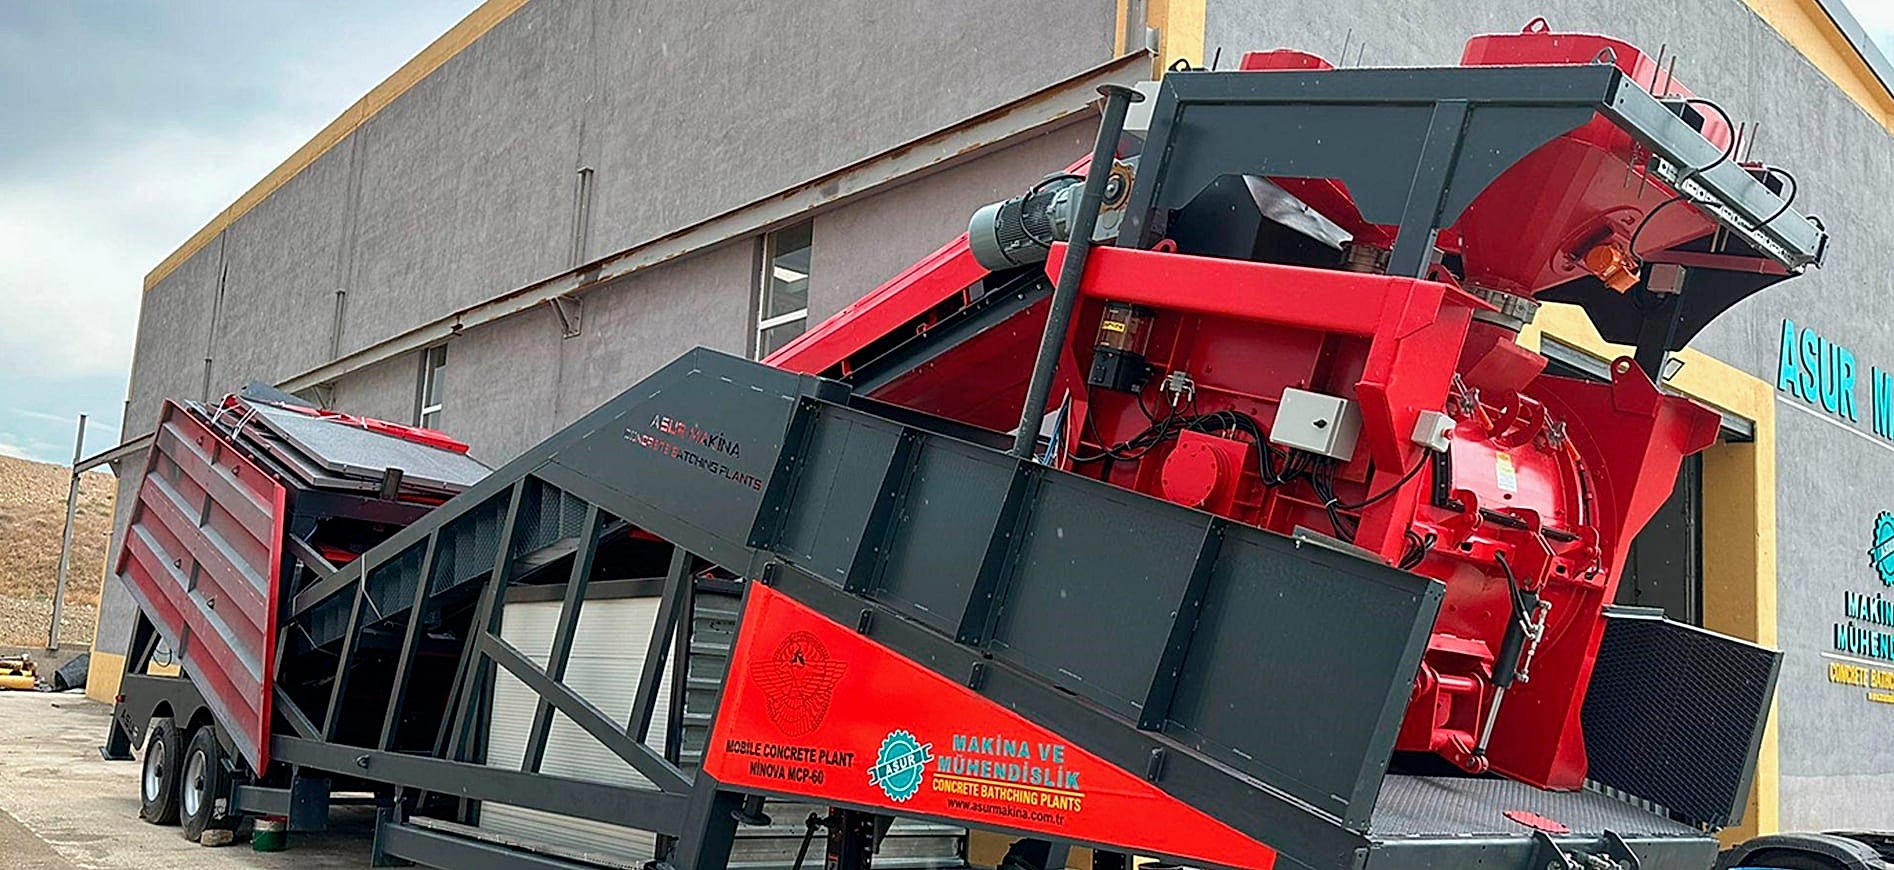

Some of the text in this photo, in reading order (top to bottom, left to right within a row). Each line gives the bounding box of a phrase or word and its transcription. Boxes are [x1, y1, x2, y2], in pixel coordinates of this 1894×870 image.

[1776, 318, 1858, 423] ASUR
[650, 414, 741, 458] ASUR MAKİNA
[717, 465, 763, 491] PLANTS
[726, 739, 855, 768] MOBİLE CONCRETE PLANT
[952, 733, 1065, 764] MAKİNA VE
[749, 760, 825, 785] NİNOVA MCP-60
[886, 754, 916, 775] ASUR
[937, 754, 1080, 791] MÜHENDİSLİK
[932, 778, 1082, 812] CONCRETE BATHCHING PLANTS
[946, 798, 1065, 825] www.asurmakina.com.tr
